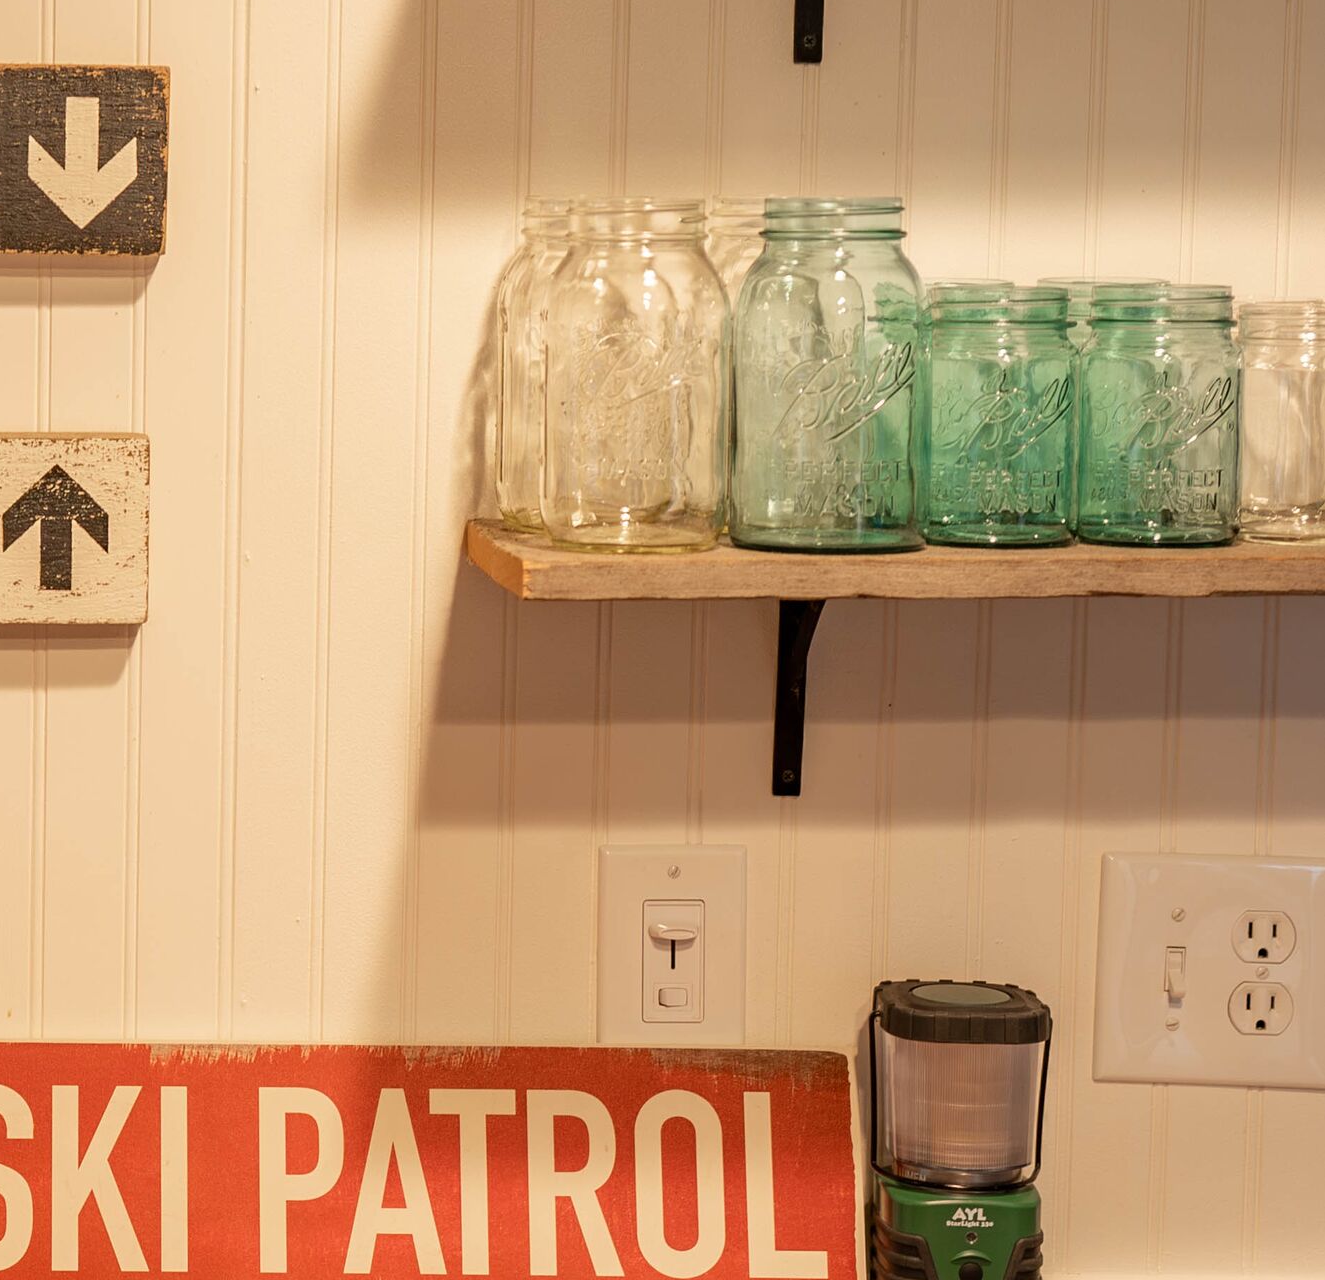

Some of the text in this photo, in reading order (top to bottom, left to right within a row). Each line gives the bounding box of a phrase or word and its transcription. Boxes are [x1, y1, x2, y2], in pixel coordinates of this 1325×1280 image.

[773, 340, 917, 442] Ball
[956, 376, 1073, 461] Ball
[1128, 376, 1235, 458] Ball
[784, 460, 903, 484] PERFECT
[1129, 469, 1223, 489] PERFECT
[259, 1086, 830, 1280] PATROL
[952, 1207, 987, 1221] AYL
